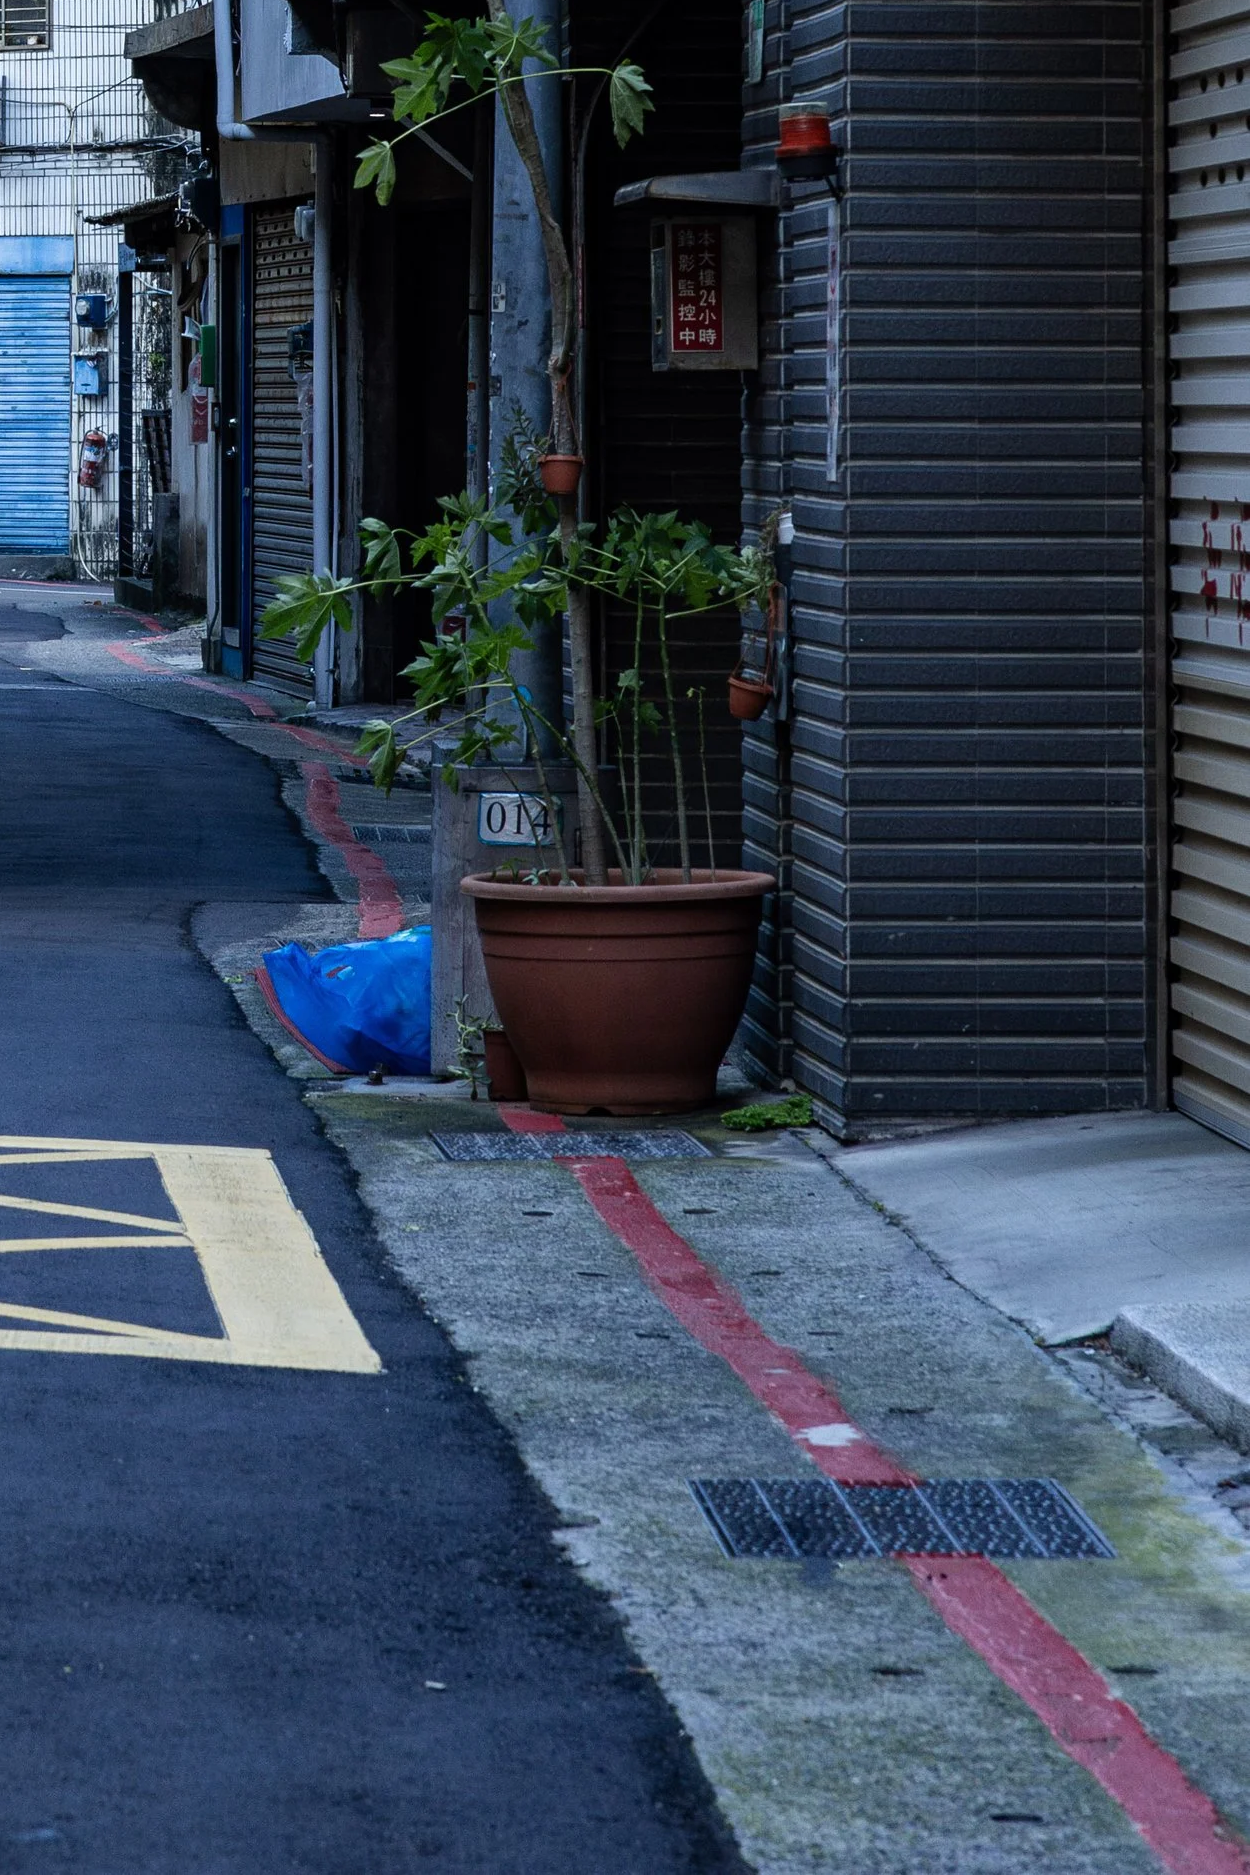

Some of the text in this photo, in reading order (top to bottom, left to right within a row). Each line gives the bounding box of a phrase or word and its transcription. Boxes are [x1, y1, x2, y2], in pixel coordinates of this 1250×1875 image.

[698, 230, 717, 346] 本大樓24小時
[486, 801, 553, 836] 014
